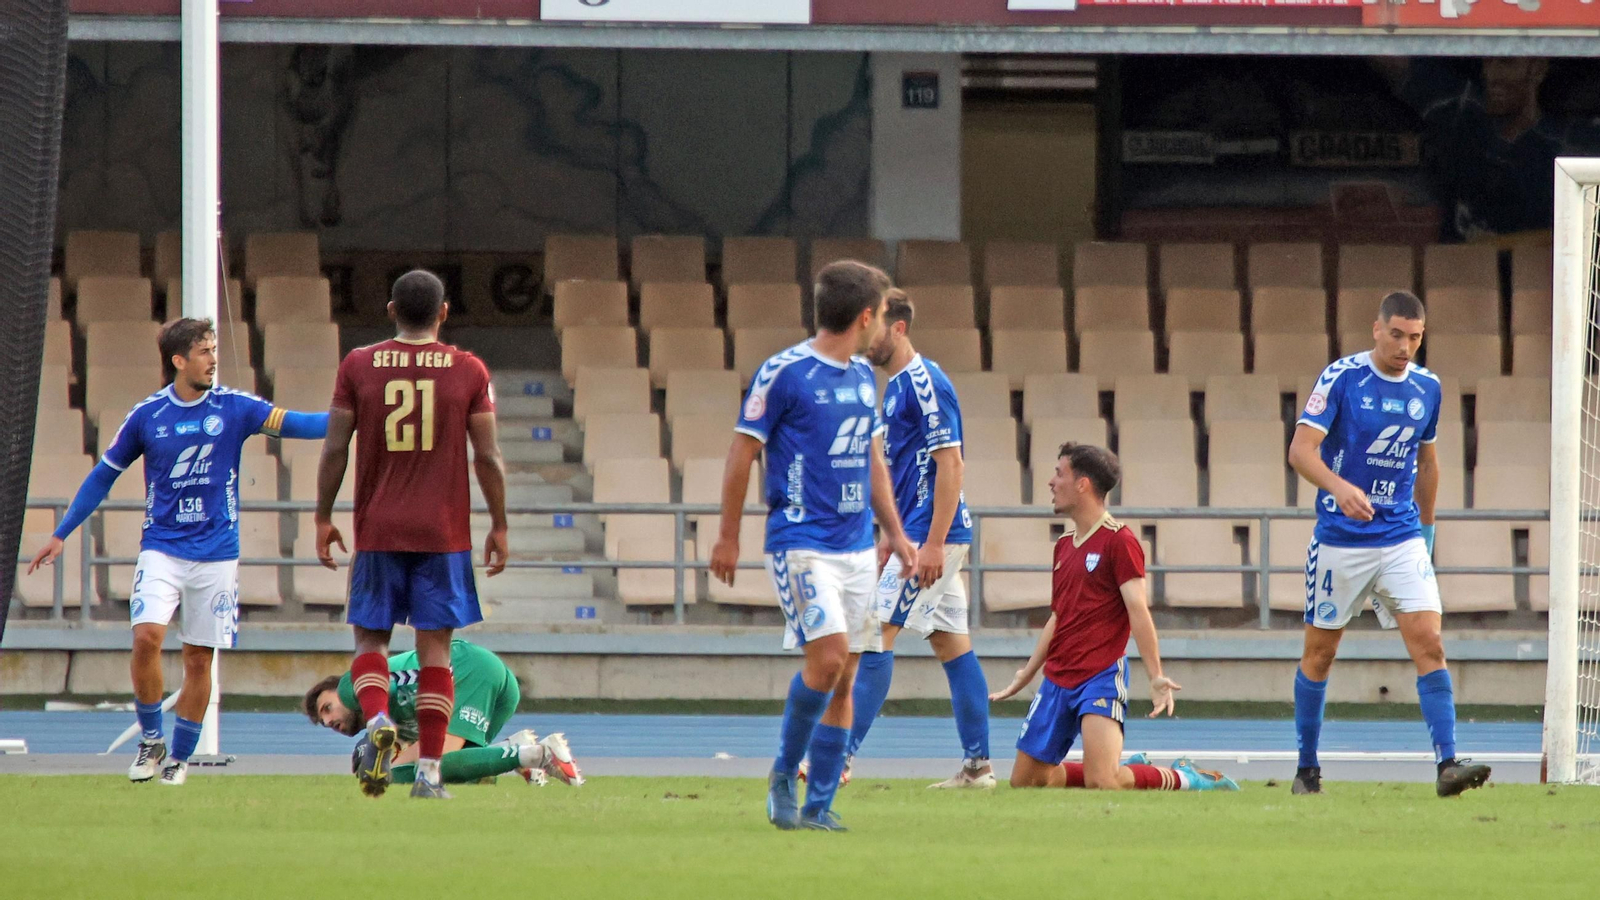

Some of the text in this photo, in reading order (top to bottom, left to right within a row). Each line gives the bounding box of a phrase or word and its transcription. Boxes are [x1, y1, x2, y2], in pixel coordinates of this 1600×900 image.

[372, 351, 453, 368] SETH VEGA
[385, 380, 434, 452] 21
[1386, 441, 1411, 458] Air
[189, 459, 212, 476] Air
[1366, 457, 1406, 470] oneair.es
[172, 477, 211, 490] oneair.es
[1371, 479, 1397, 496] L3G
[178, 497, 203, 513] L3G
[175, 512, 207, 523] MARKETING
[133, 569, 144, 594] 2
[793, 570, 818, 602] 15
[1321, 569, 1334, 597] 4
